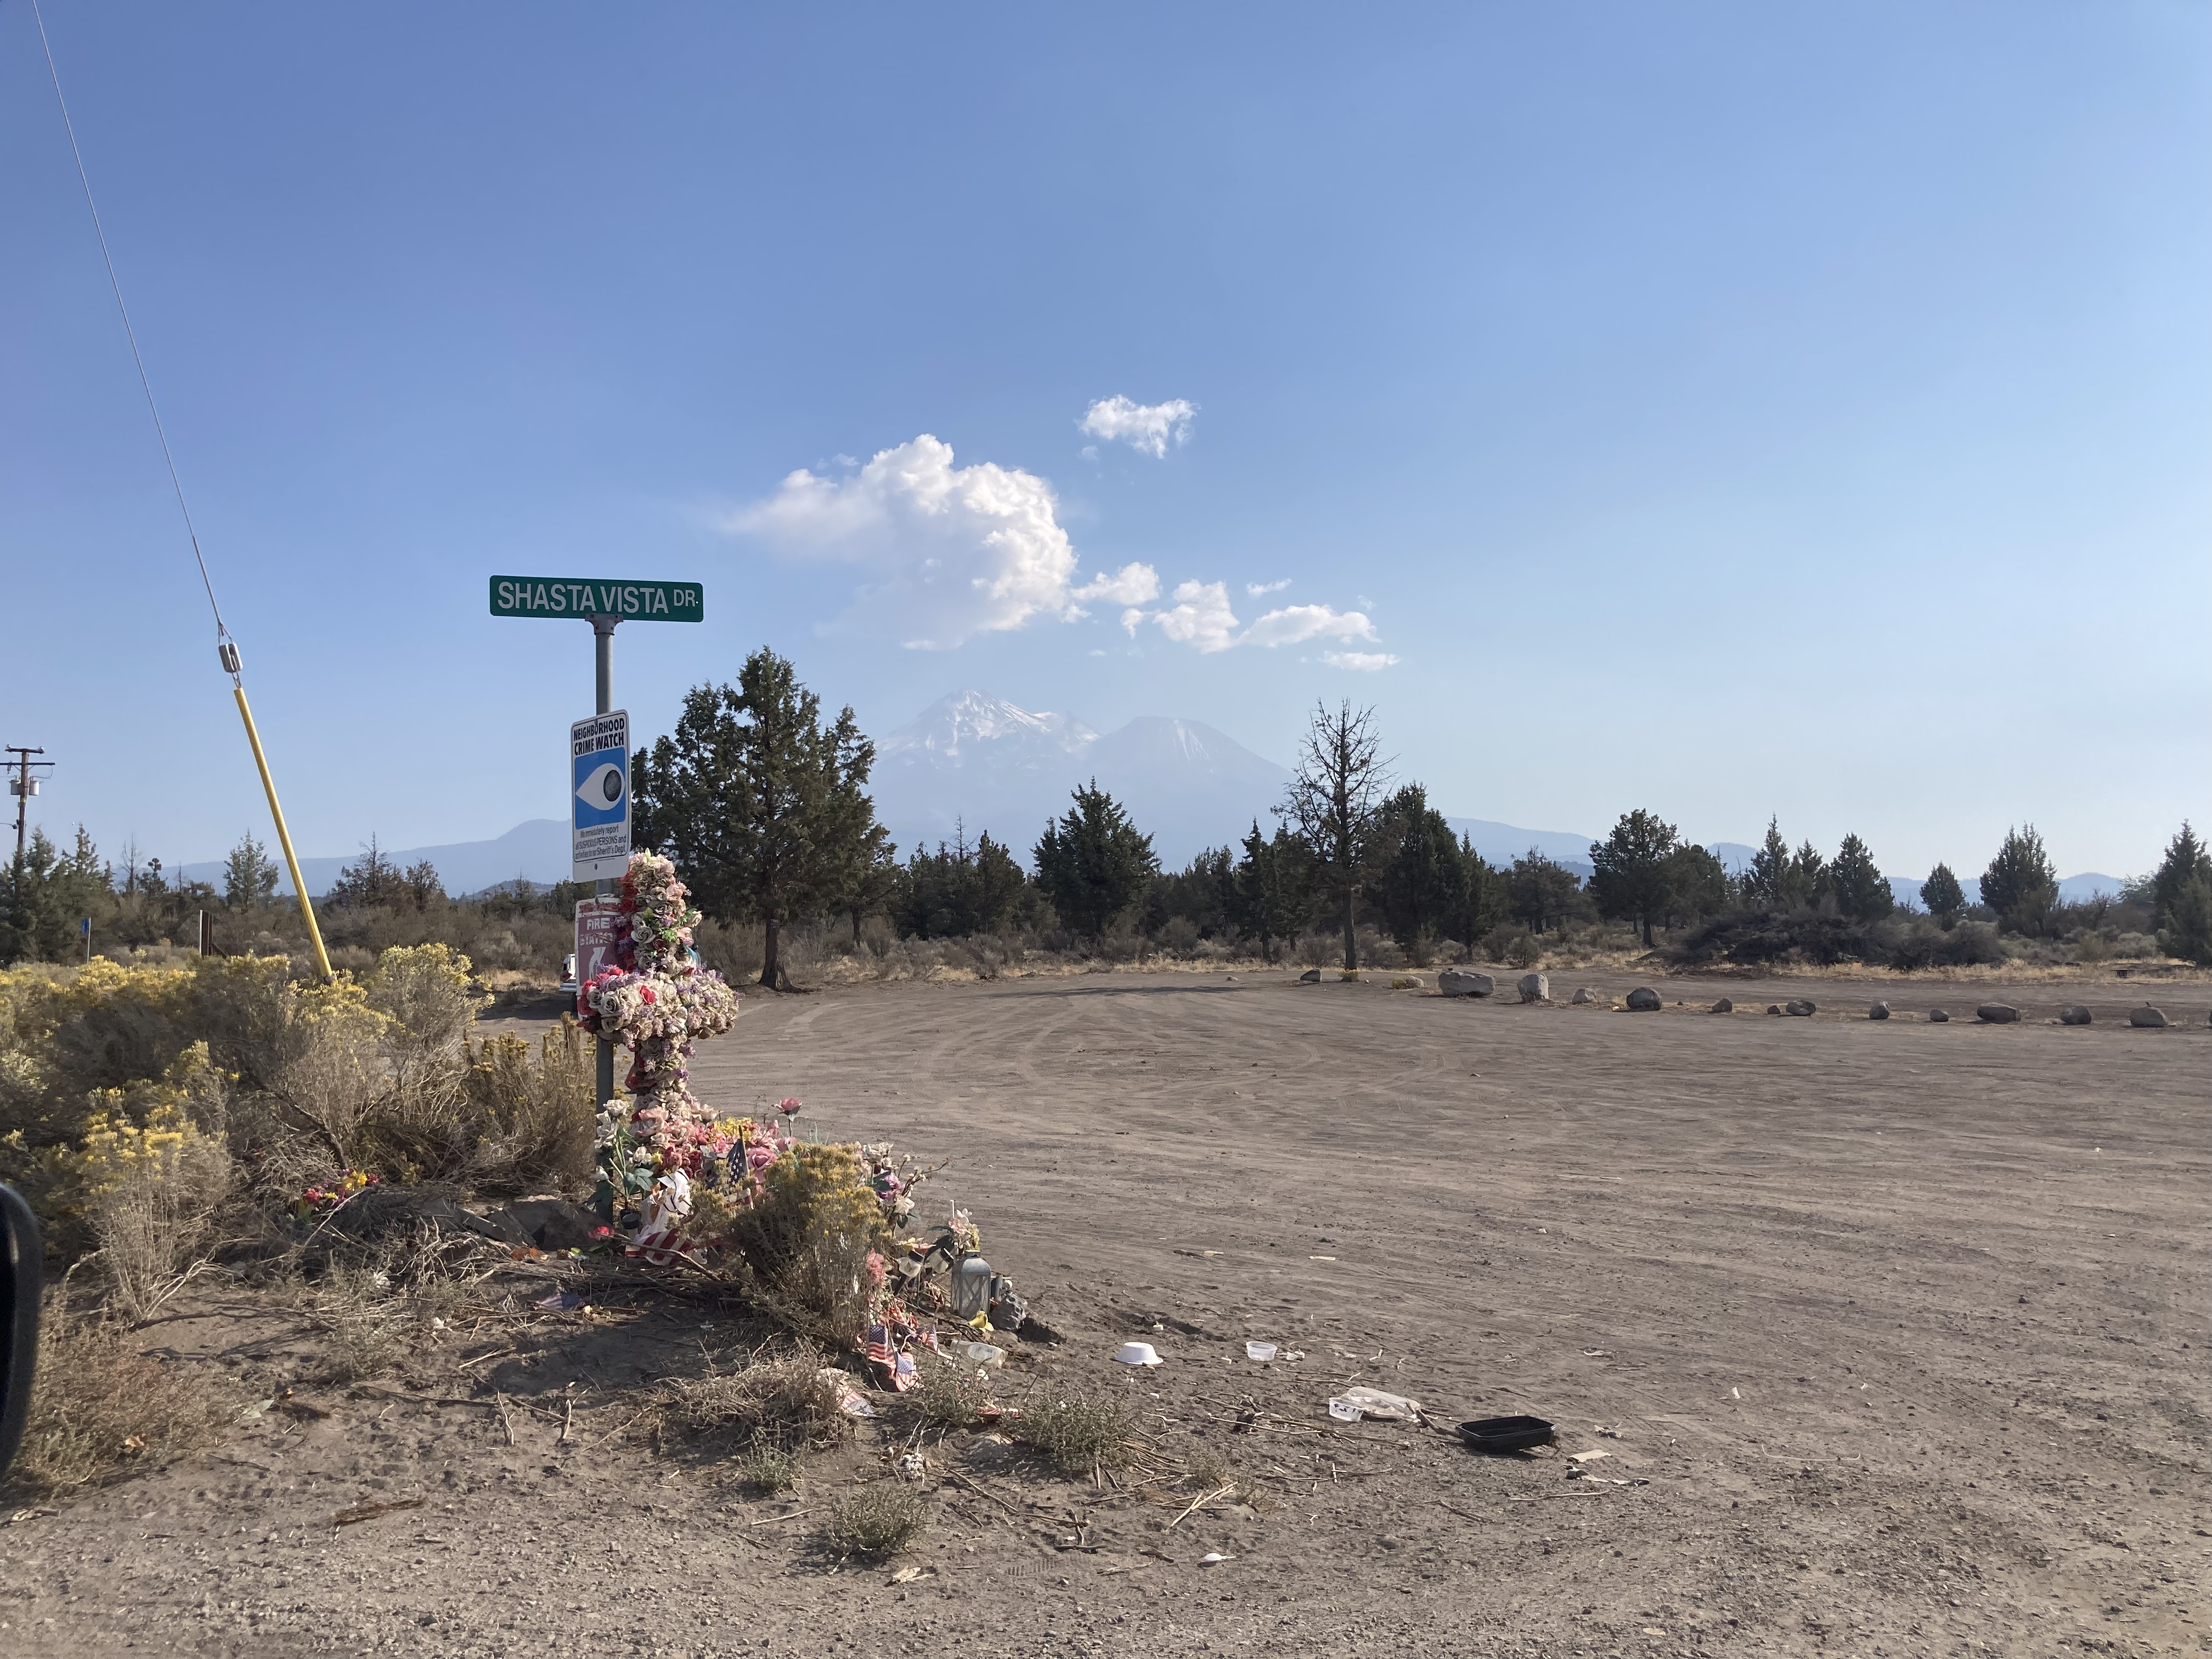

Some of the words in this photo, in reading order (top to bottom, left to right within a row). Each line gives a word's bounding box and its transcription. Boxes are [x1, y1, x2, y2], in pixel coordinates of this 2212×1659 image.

[498, 582, 597, 611] SHASTA
[600, 585, 669, 614] VISTA
[573, 718, 625, 741] NEIGHBORHOOD
[574, 738, 594, 755] CRIME
[595, 731, 624, 750] WATCH
[605, 824, 619, 834] report
[597, 835, 618, 845] PERSONS
[618, 834, 627, 843] and
[586, 917, 611, 930] FIRE
